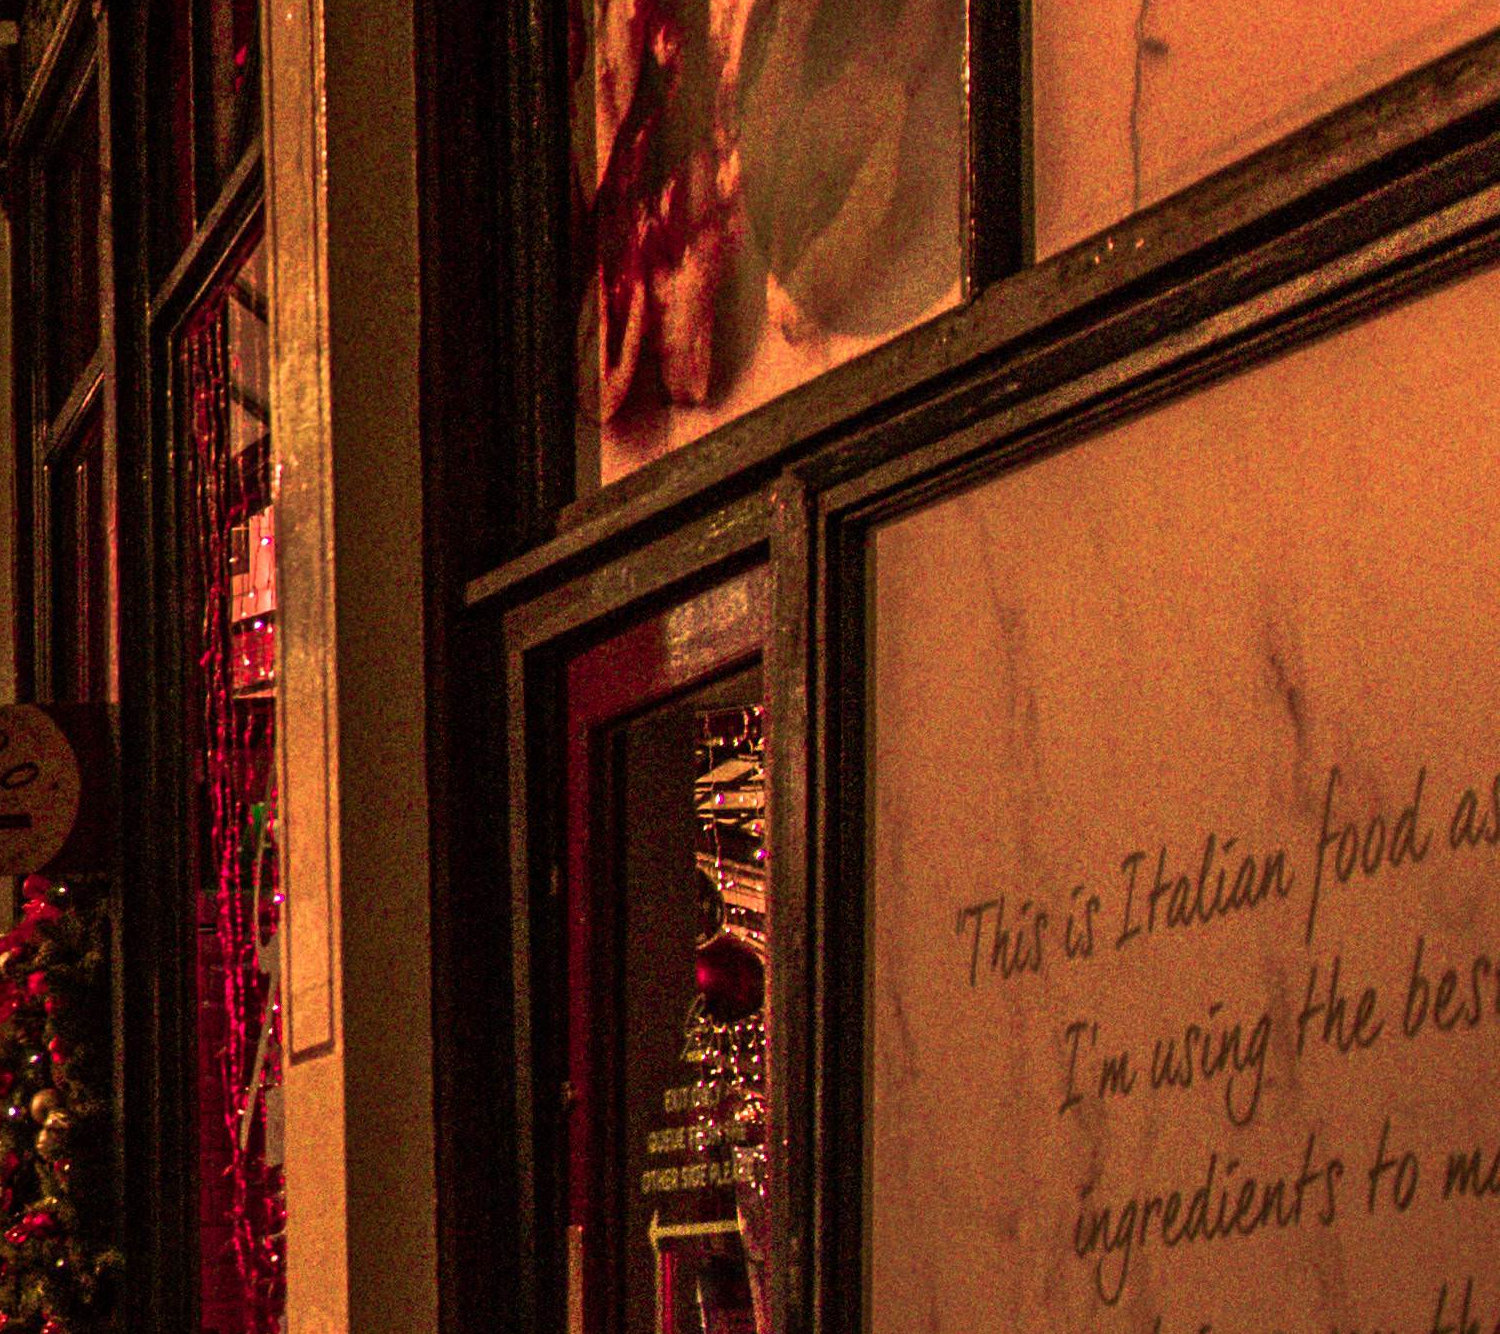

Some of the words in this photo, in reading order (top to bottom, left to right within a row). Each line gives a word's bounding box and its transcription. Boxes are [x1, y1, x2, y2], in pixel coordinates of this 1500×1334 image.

[1065, 885, 1101, 959] is
[1116, 836, 1294, 950] Italian
[1306, 766, 1430, 946] food
[1059, 1020, 1138, 1116] I'm
[1150, 1004, 1274, 1127] using
[1297, 957, 1385, 1054] the
[1073, 1133, 1343, 1308] ingredients
[1368, 1117, 1421, 1217] to
